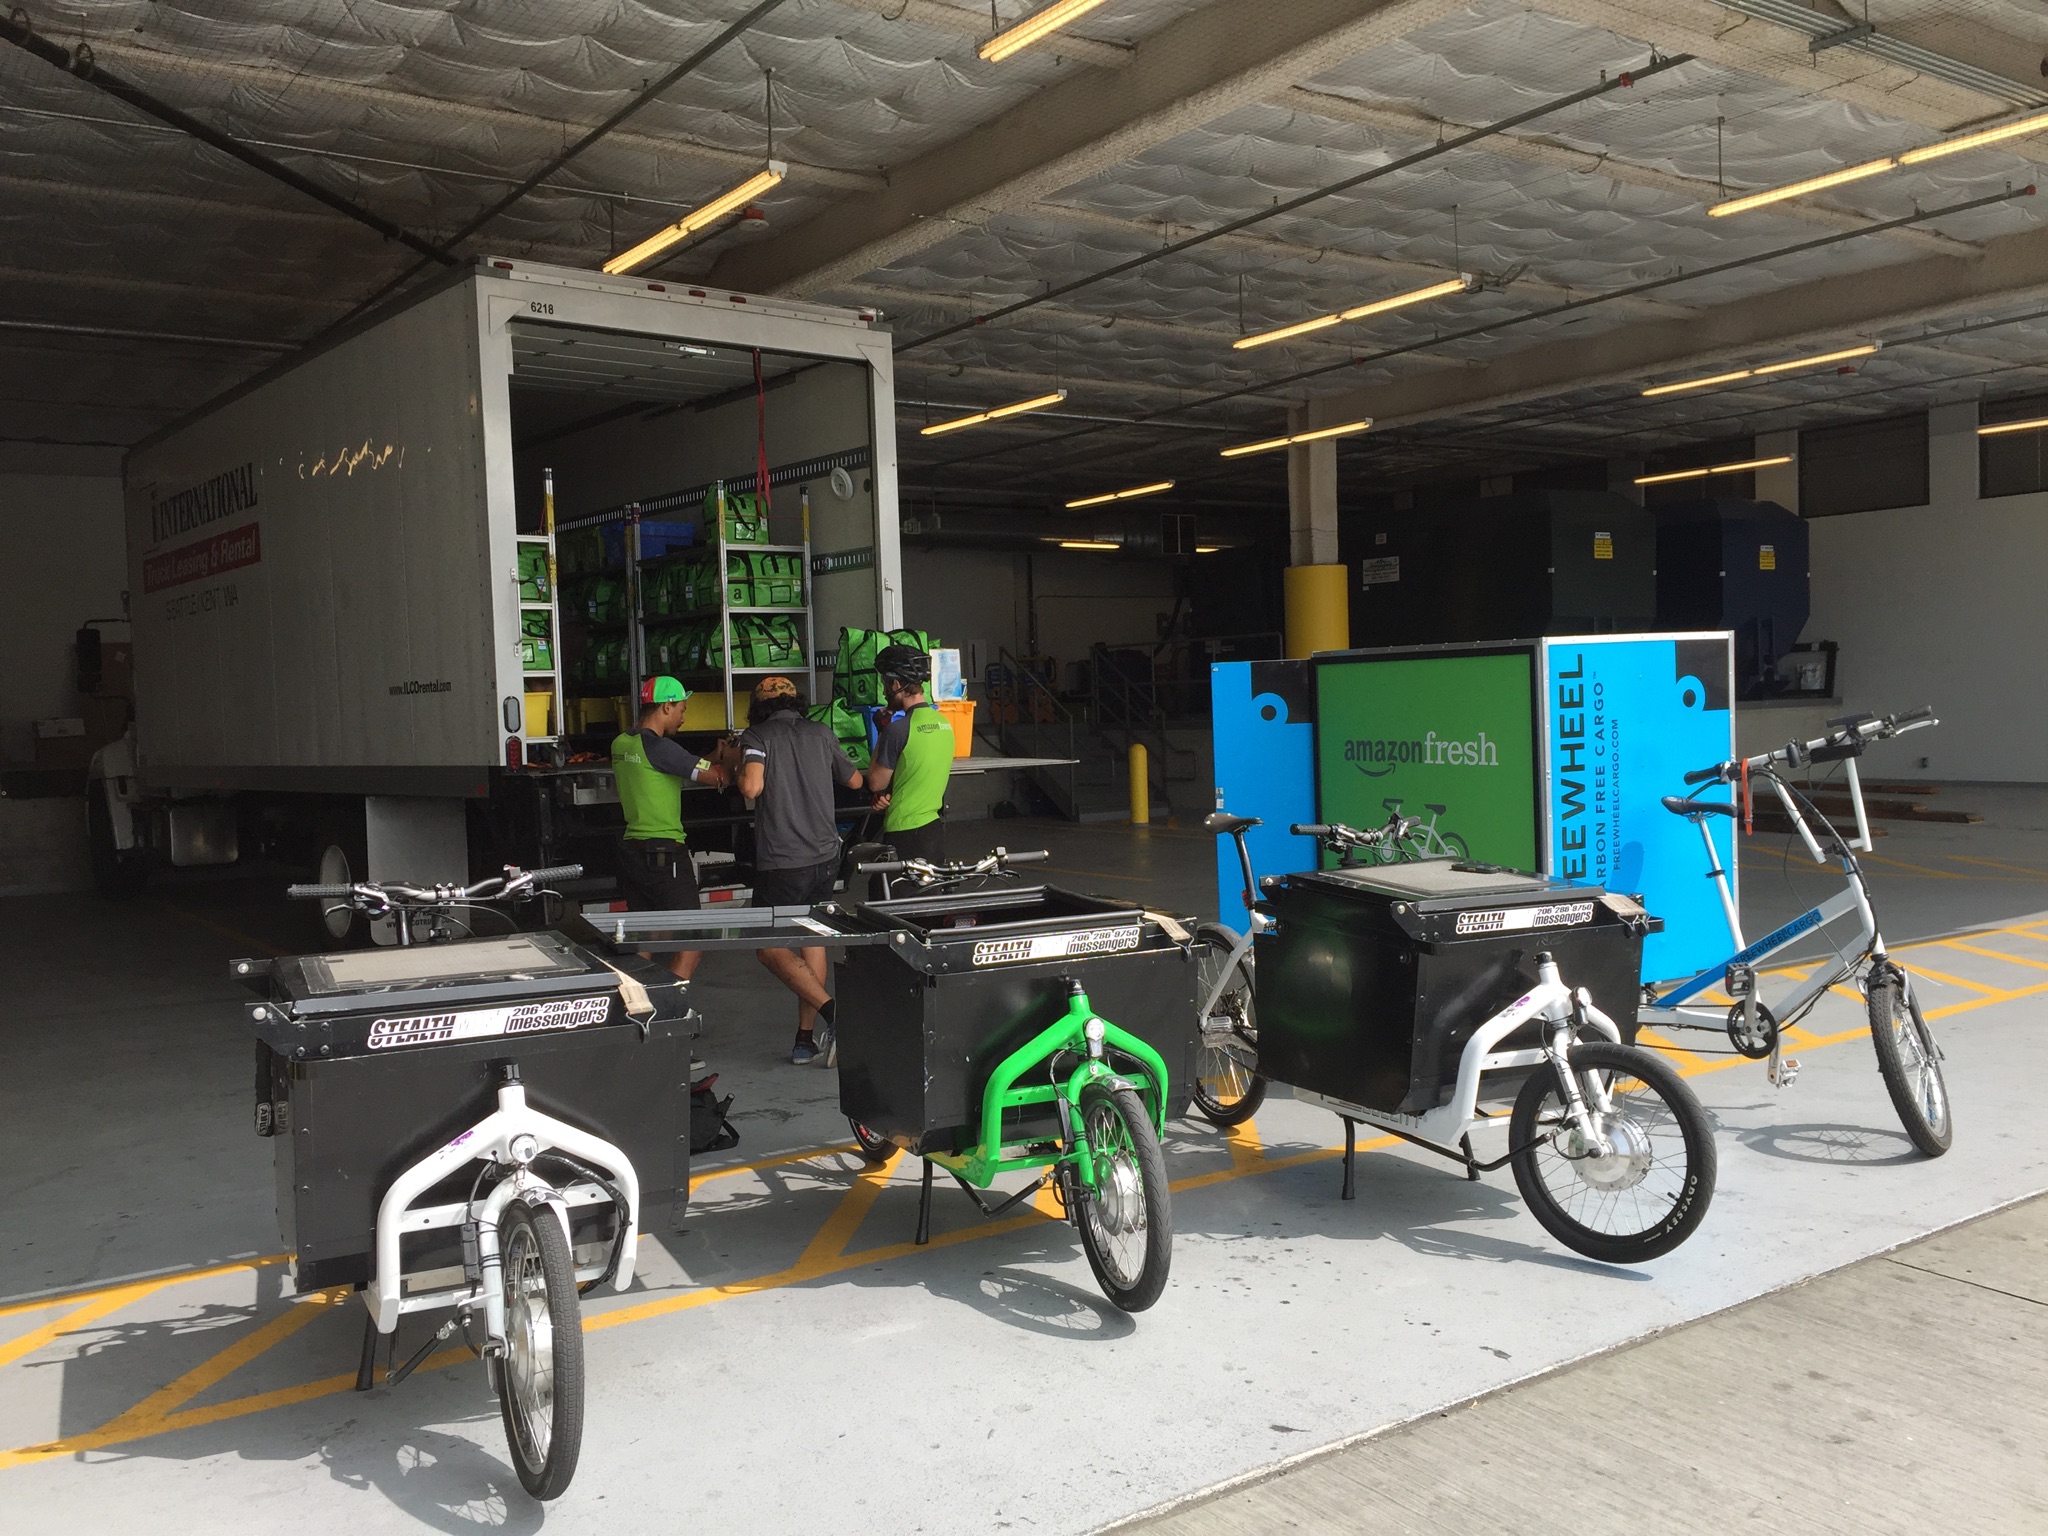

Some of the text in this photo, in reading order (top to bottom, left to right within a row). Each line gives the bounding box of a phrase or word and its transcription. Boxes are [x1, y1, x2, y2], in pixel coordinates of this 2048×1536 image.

[531, 301, 554, 315] 6218
[142, 463, 258, 551] INTERNATIONAL
[146, 560, 171, 586] Truck
[172, 550, 208, 580] Leasing
[221, 529, 256, 564] Rental
[1594, 765, 1606, 814] FREE
[1611, 719, 1621, 871] FREEWHEELCARGO.COM
[1457, 912, 1506, 933] STEALTH
[1534, 911, 1592, 926] messengers
[974, 940, 1033, 963] STEALTH
[1069, 936, 1138, 953] messengers
[370, 1015, 456, 1047] STEALTH
[507, 1008, 606, 1031] messengers
[1666, 1174, 1698, 1234] ODYSSEY
